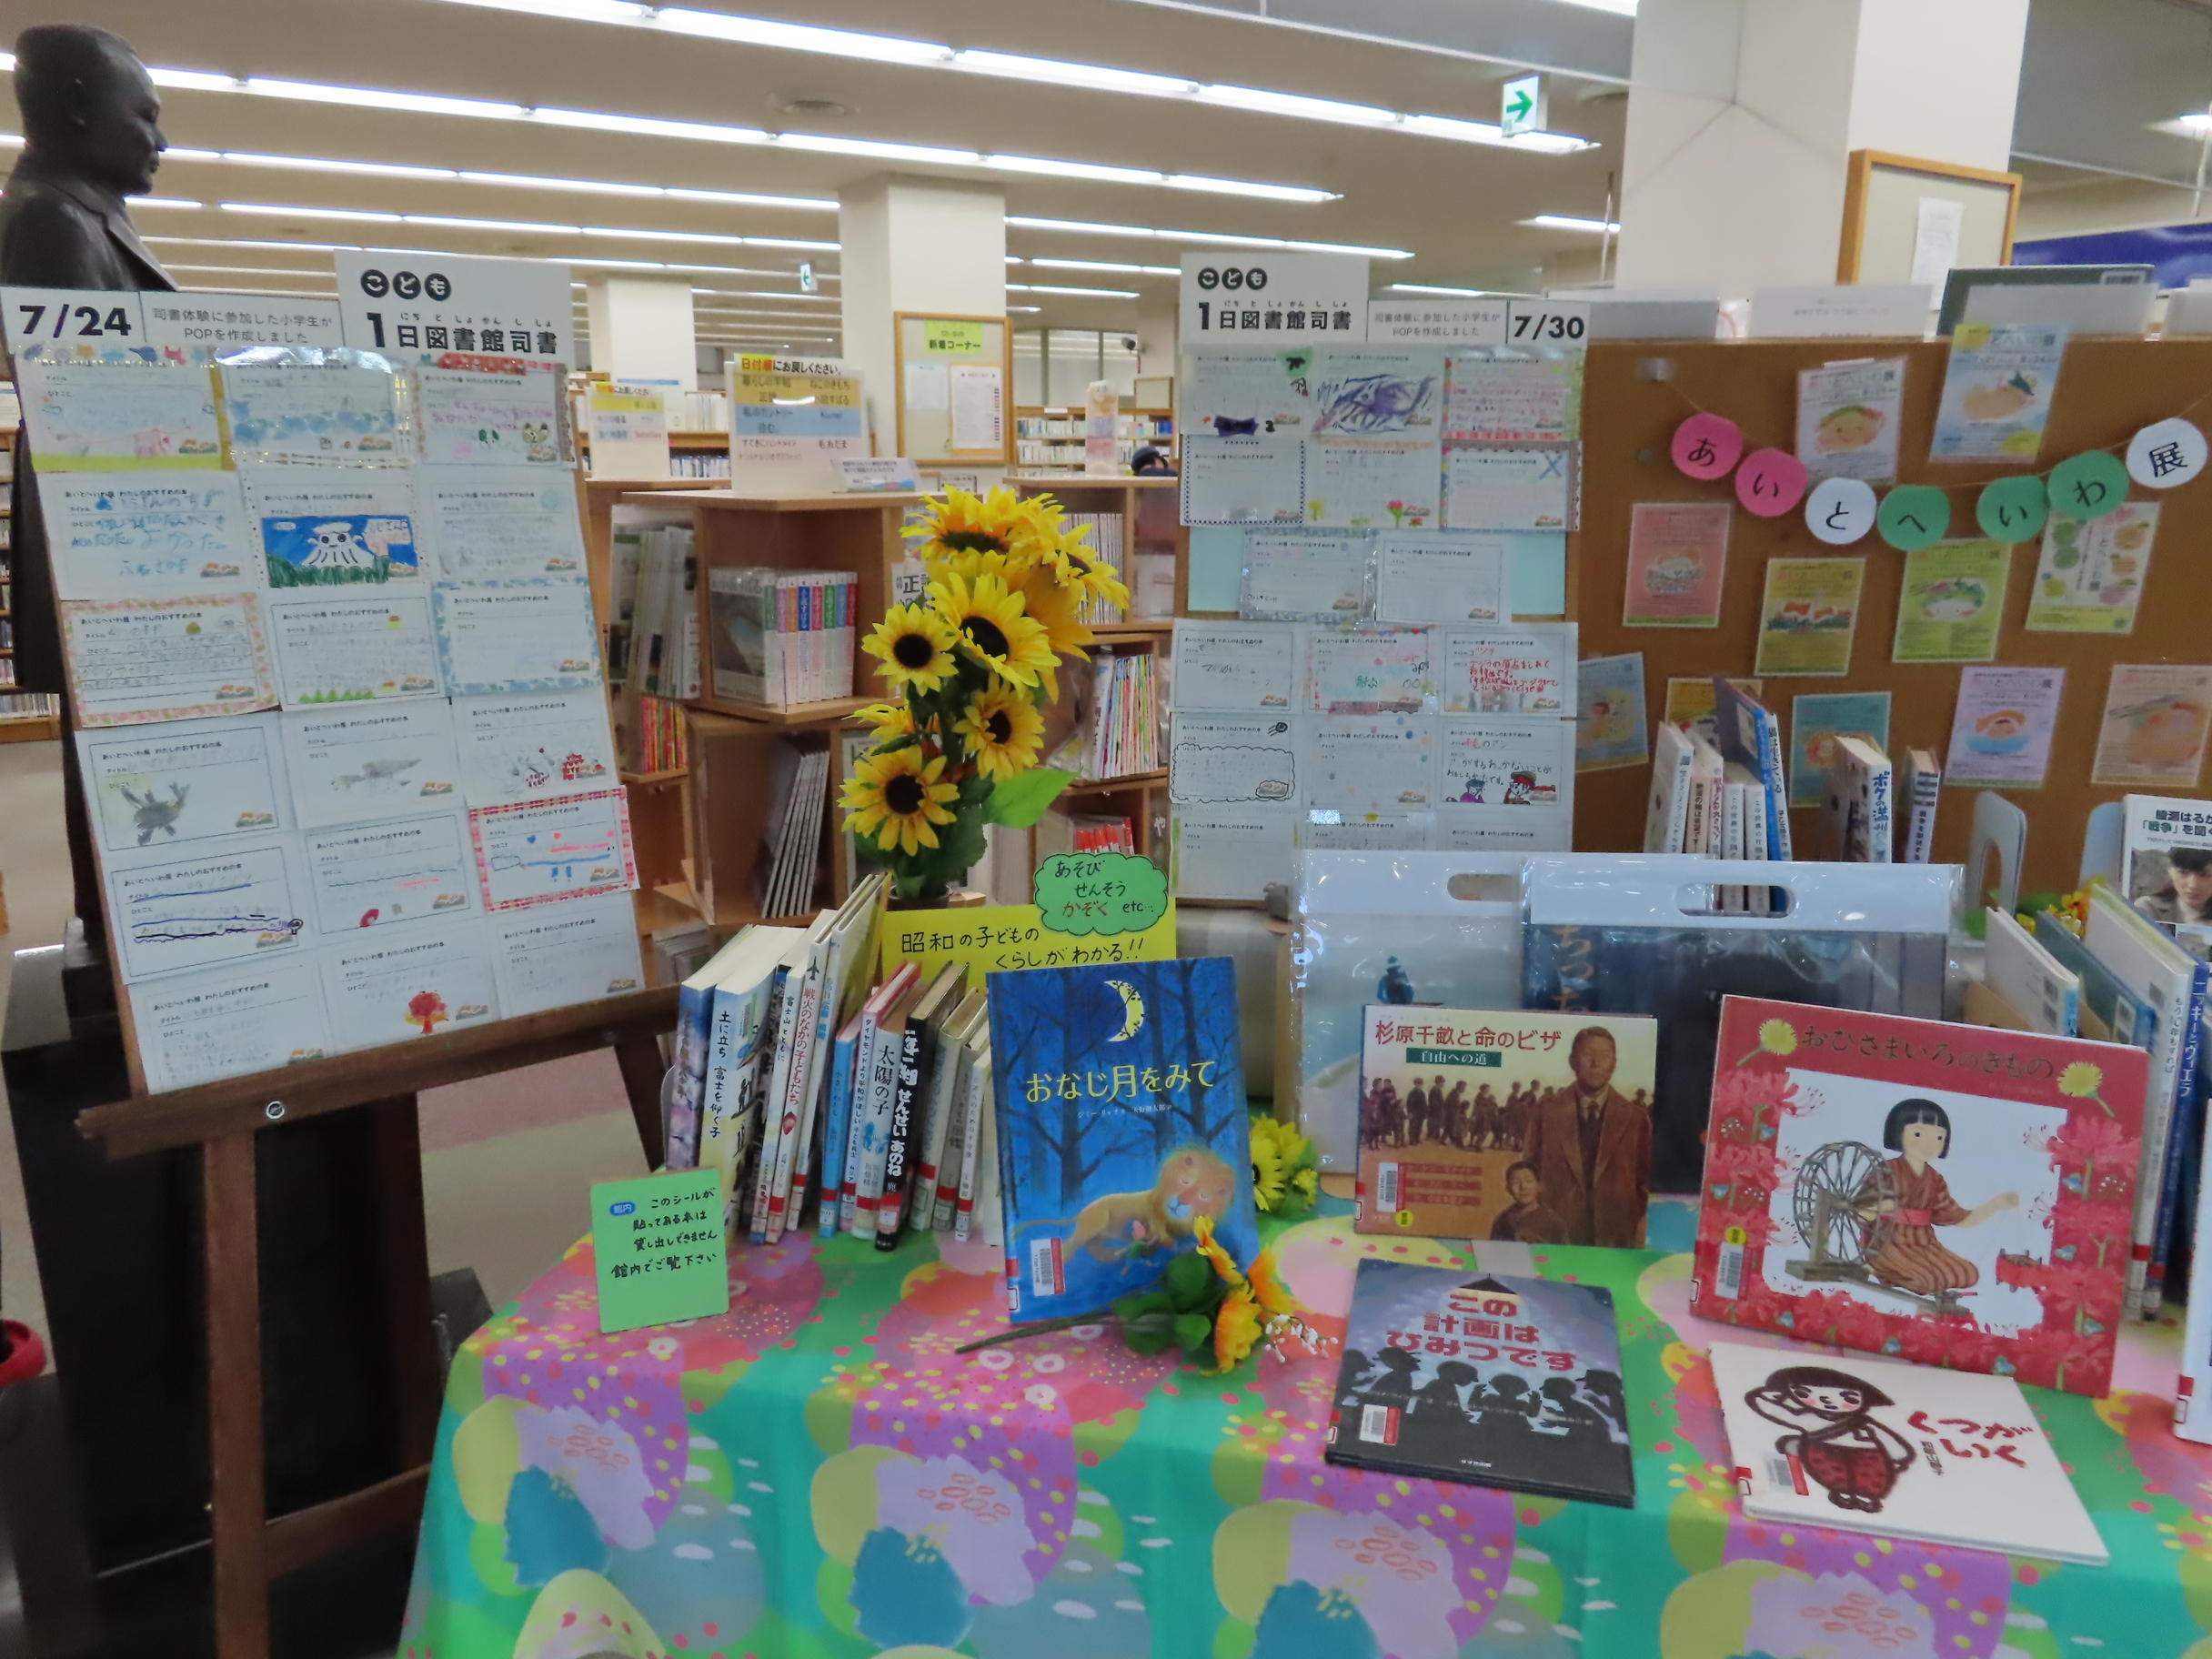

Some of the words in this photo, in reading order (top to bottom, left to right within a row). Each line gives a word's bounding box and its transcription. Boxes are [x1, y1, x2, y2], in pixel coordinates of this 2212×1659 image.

[362, 270, 449, 300] こども
[1198, 267, 1268, 290] こども
[19, 304, 132, 338] 7/24
[153, 307, 333, 328] 司書体験に参加した小学生が
[1198, 302, 1352, 331] 1日図書館司書
[1374, 312, 1501, 323] 司書体験に参加した小学生が
[1393, 326, 1480, 337] POPを作成しました
[1513, 314, 1585, 340] 7/30
[184, 327, 308, 344] POPを作成しました
[367, 312, 558, 355] 1日図書館司書
[741, 357, 841, 376] 日付順にお戻しください。
[1688, 438, 2188, 534] あいとへいわ展
[1872, 770, 1890, 831] ボクの満州
[1153, 815, 1166, 837] や
[1054, 860, 1106, 879] あそび
[1073, 880, 1127, 898] せんそう
[1062, 900, 1109, 918] かぞく
[901, 927, 1040, 954] 昭和の子どもの
[995, 938, 1144, 970] くらしがわかる!!
[717, 1010, 732, 1060] 土に立ち
[778, 996, 795, 1062] 富士山とともに
[1374, 1019, 1563, 1052] 杉原千畝と命のビザ
[789, 987, 816, 1106] 戦火のなかの子どもたち
[901, 1029, 920, 1086] 一年一組
[1421, 1051, 1488, 1067] 自由への道
[1802, 1025, 2055, 1080] おひさまいろのきもの
[853, 1019, 872, 1124] ダイヤモンドより平和がほしい
[873, 1044, 896, 1116] 太陽の子
[1026, 1061, 1216, 1103] おなじ月をみて
[709, 1065, 727, 1139] 富士を仰ぐ子
[892, 1088, 912, 1137] せんせい
[887, 1140, 905, 1177] あのね
[650, 1187, 716, 1209] このシールが
[633, 1210, 708, 1232] 貼ってある本は
[633, 1230, 718, 1252] 貸し出しできません
[610, 1253, 717, 1279] 館内でご覧下さい
[1447, 1293, 1519, 1318] この
[1423, 1312, 1541, 1344] 計画は
[1386, 1330, 1578, 1372] ひみつです
[1907, 1411, 2035, 1441] くつが
[1938, 1438, 2027, 1469] いく
